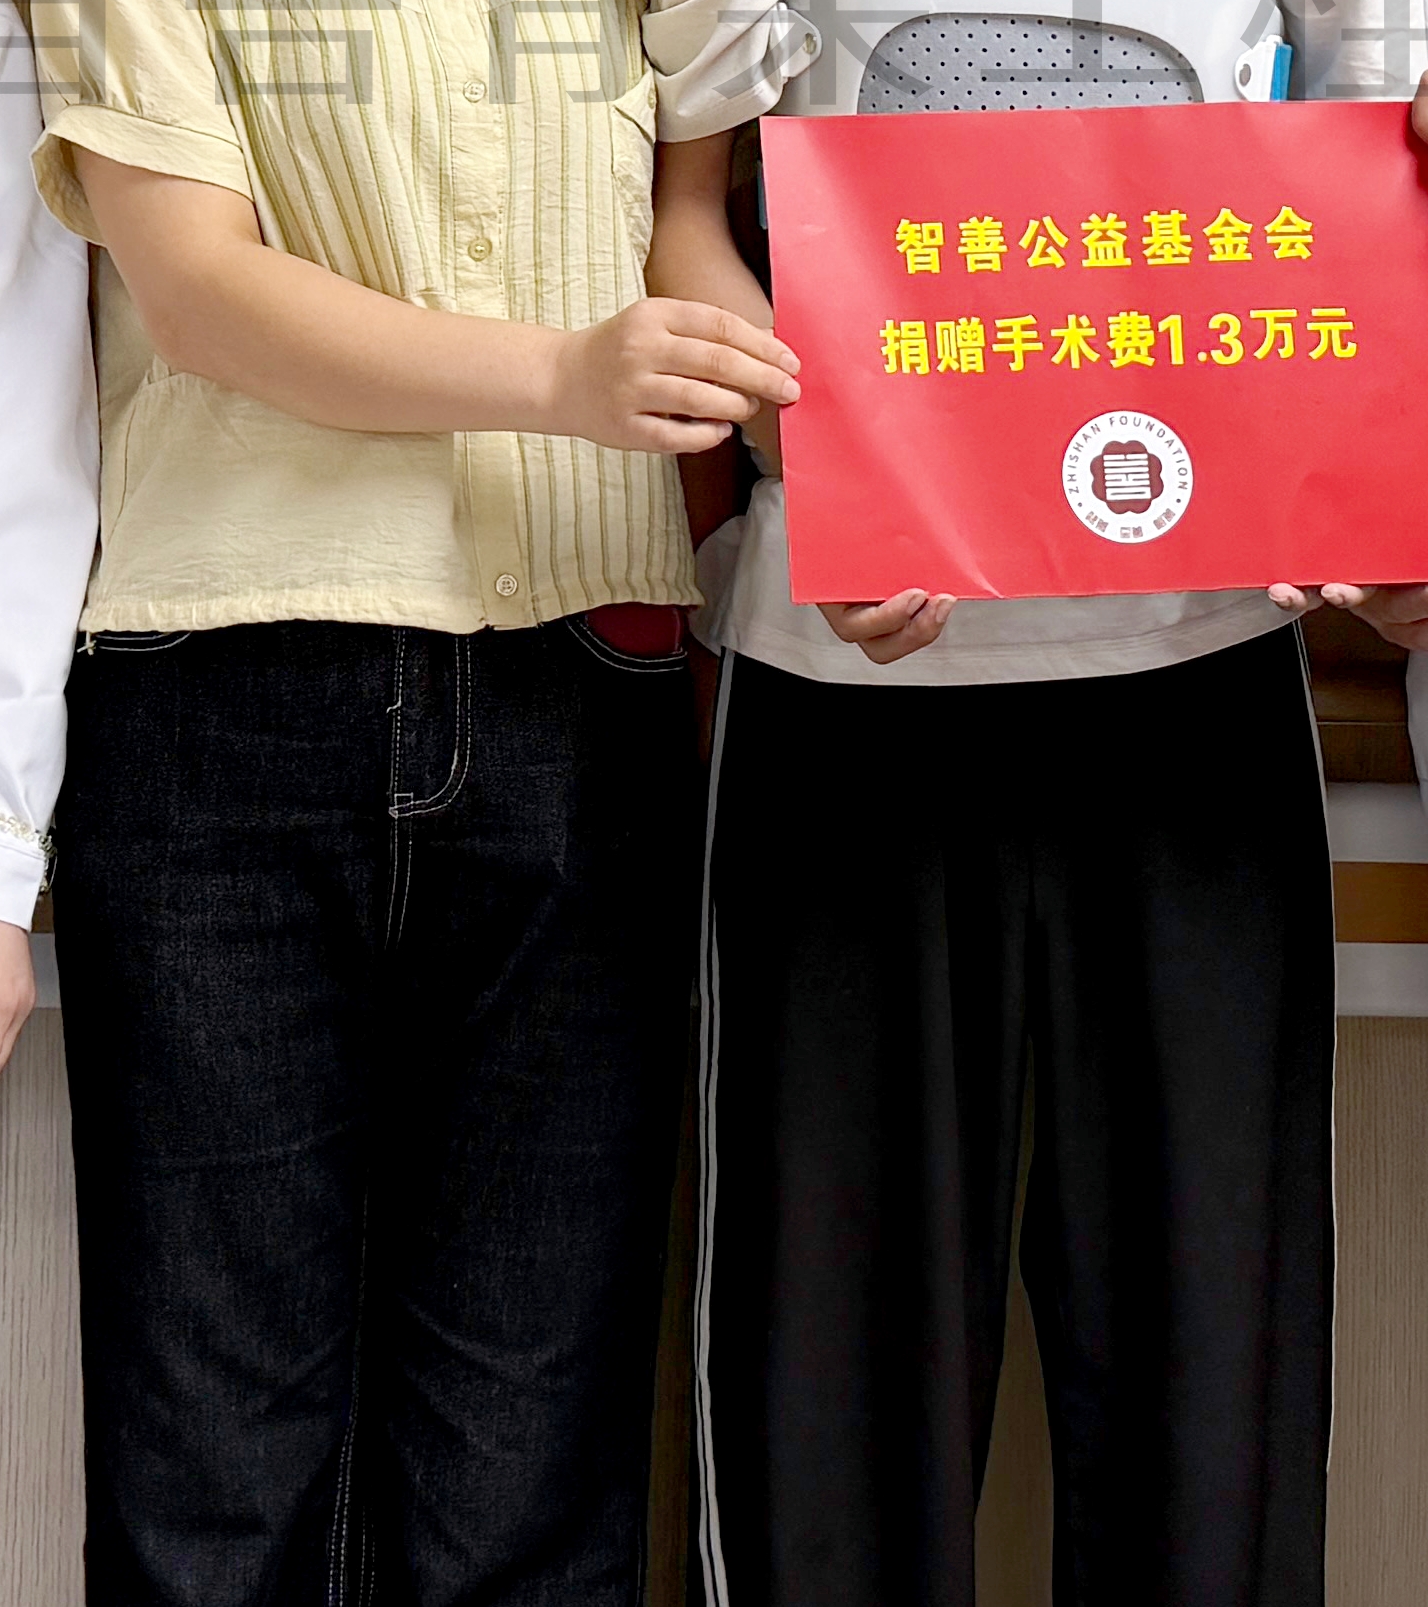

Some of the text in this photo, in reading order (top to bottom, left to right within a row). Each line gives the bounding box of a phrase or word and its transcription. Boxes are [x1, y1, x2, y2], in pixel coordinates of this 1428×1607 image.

[896, 205, 1315, 275] 智善公益基金会
[879, 307, 1358, 376] 捐赠手术费1.3万元
[1108, 415, 1189, 490] FOUNDATION
